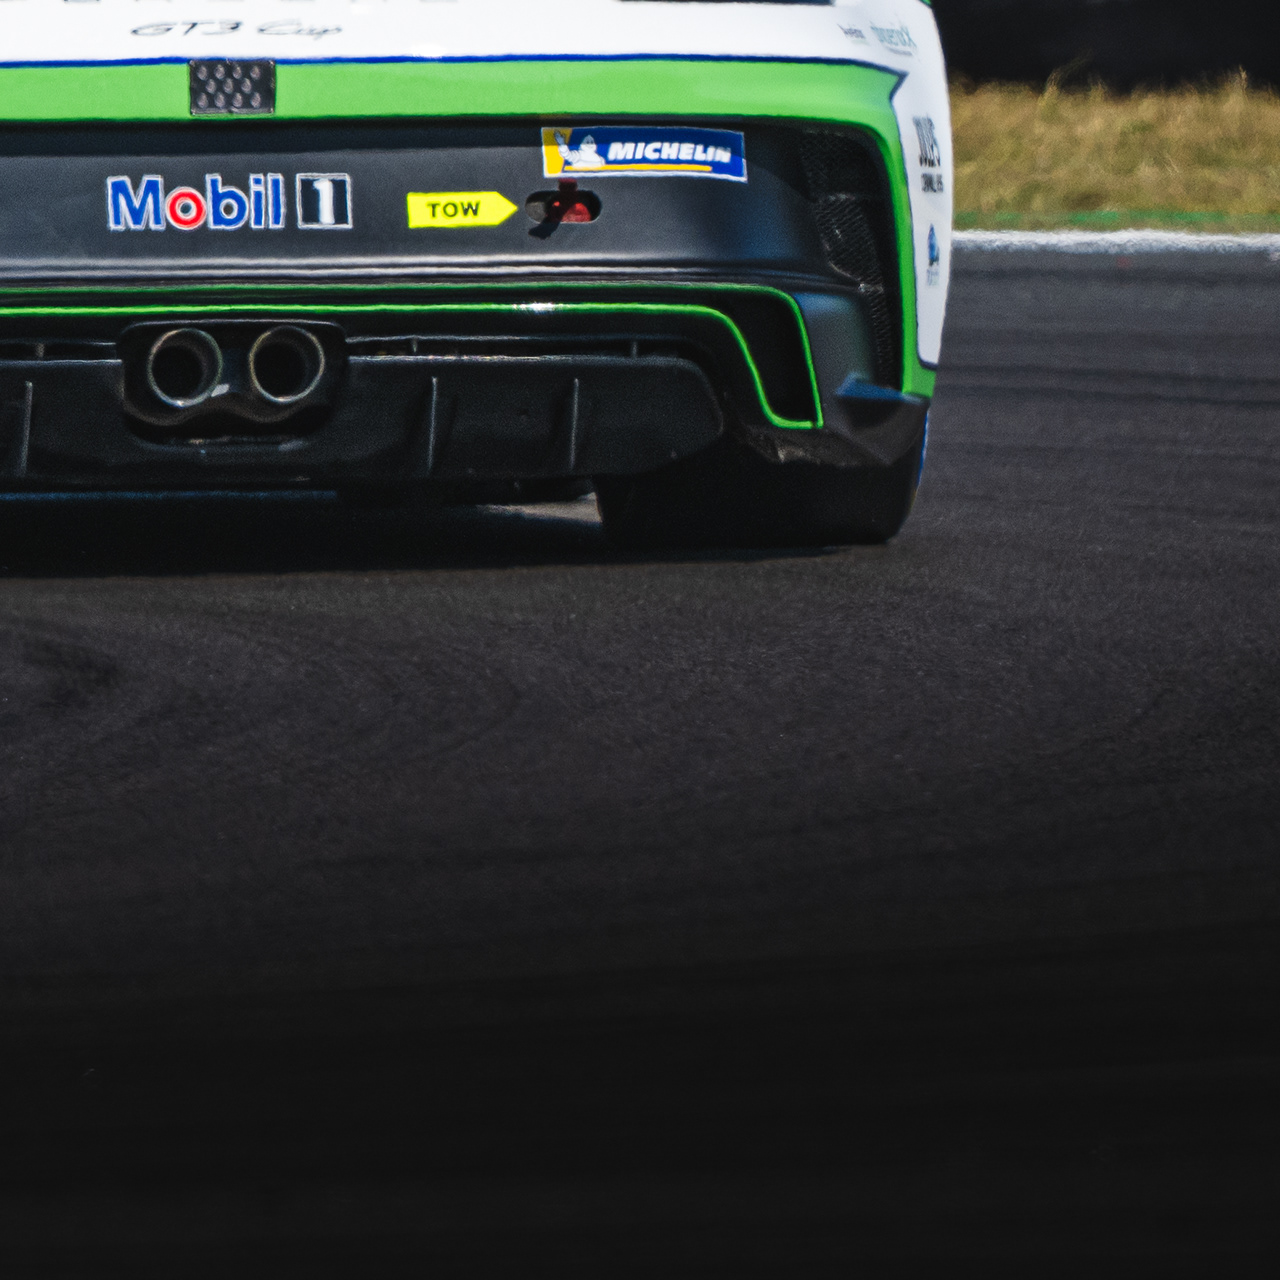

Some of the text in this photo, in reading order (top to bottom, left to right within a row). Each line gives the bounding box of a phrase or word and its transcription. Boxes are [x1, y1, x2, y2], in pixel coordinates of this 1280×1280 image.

[130, 18, 344, 40] GT3 Cup
[607, 141, 732, 163] MICHELIN
[107, 173, 286, 230] Mobil
[426, 201, 481, 219] TOW
